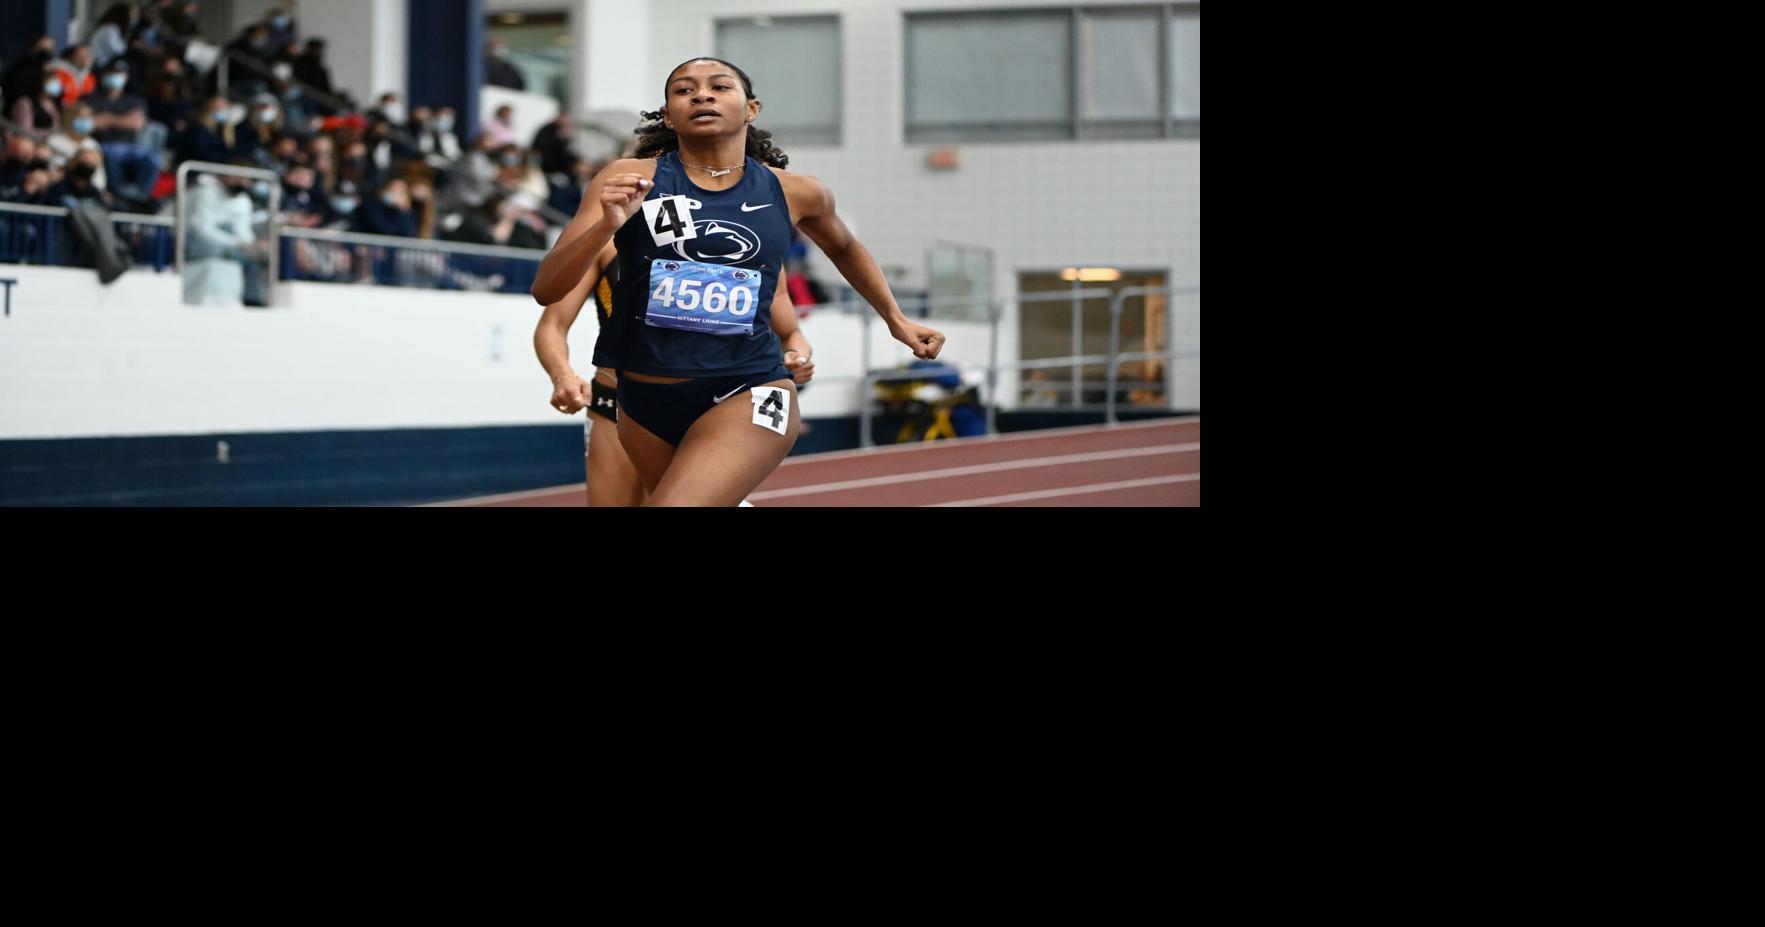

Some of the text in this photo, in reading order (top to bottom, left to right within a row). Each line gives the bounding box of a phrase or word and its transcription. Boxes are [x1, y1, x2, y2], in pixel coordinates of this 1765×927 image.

[654, 199, 687, 238] 4
[652, 277, 753, 316] 4560
[758, 389, 784, 429] 4
